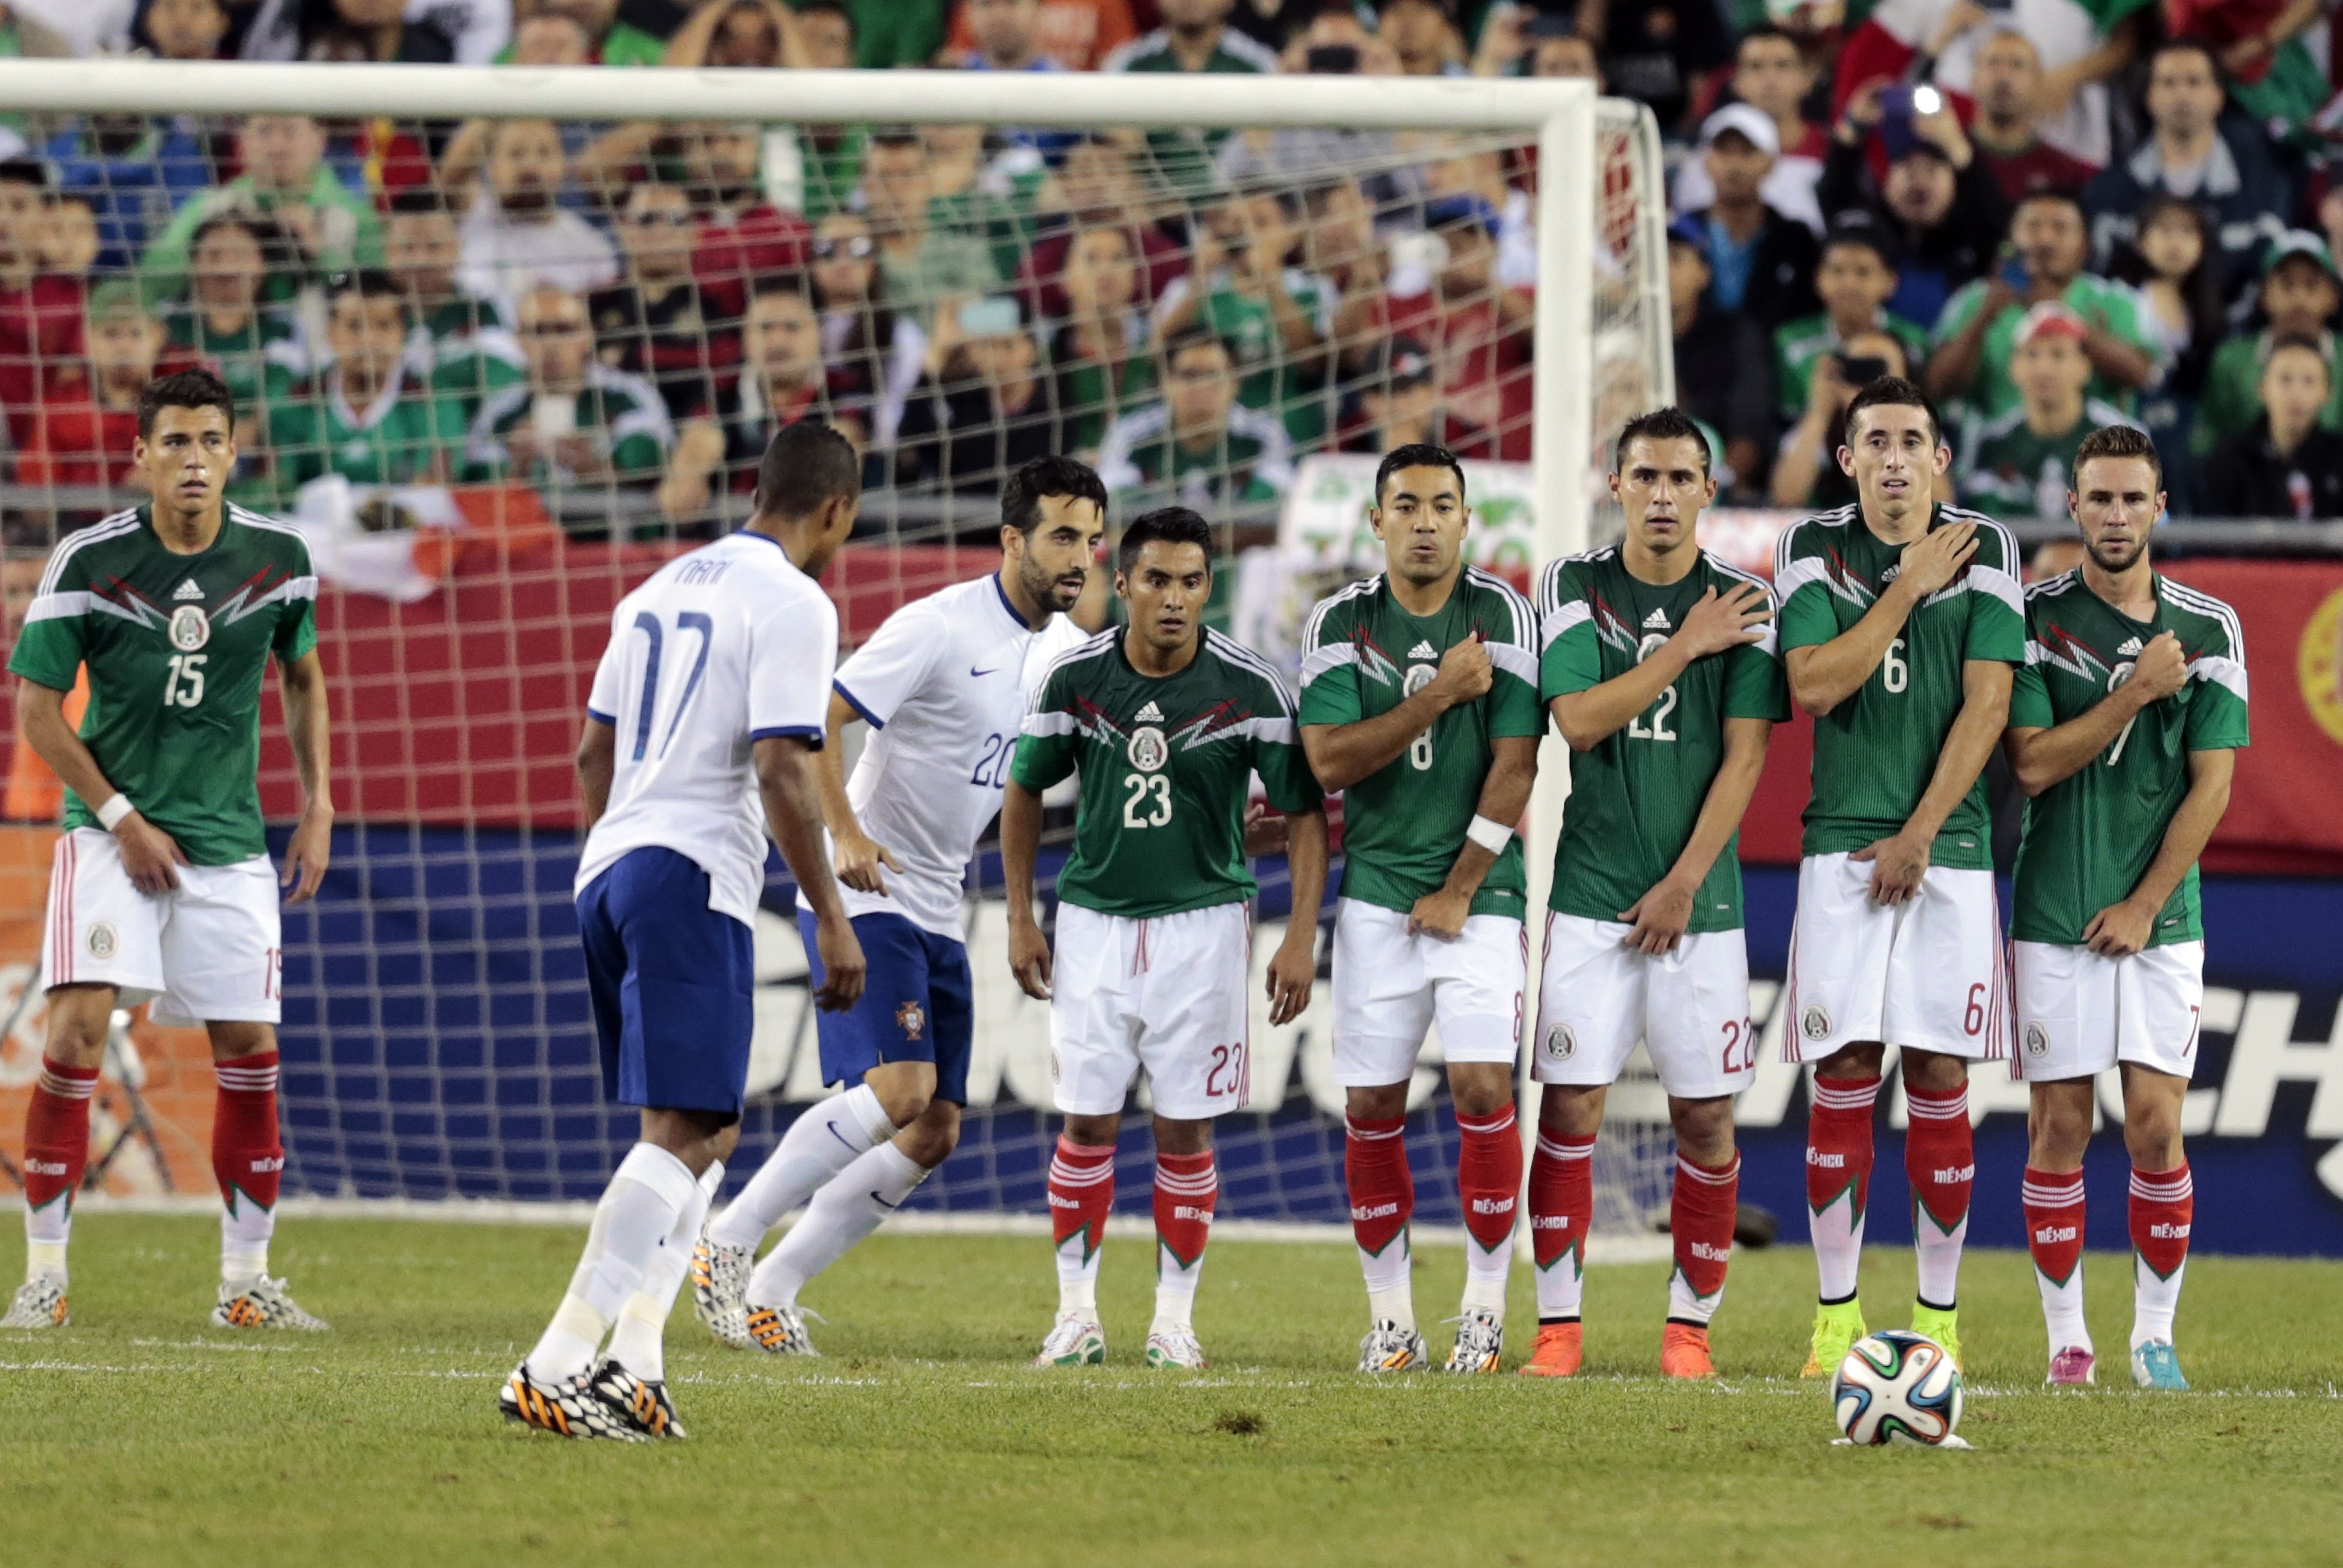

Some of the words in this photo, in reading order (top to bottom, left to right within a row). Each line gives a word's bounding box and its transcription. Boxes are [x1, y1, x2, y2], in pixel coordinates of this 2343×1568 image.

[164, 654, 208, 708] 15
[632, 612, 713, 761] 17
[1883, 638, 1908, 694] 6
[970, 732, 1020, 789] 20
[1123, 773, 1172, 828] 23
[1963, 982, 1986, 1036] 6
[2181, 1004, 2200, 1057] 7
[1206, 1042, 1242, 1096] 23
[1721, 1015, 1754, 1074] 22
